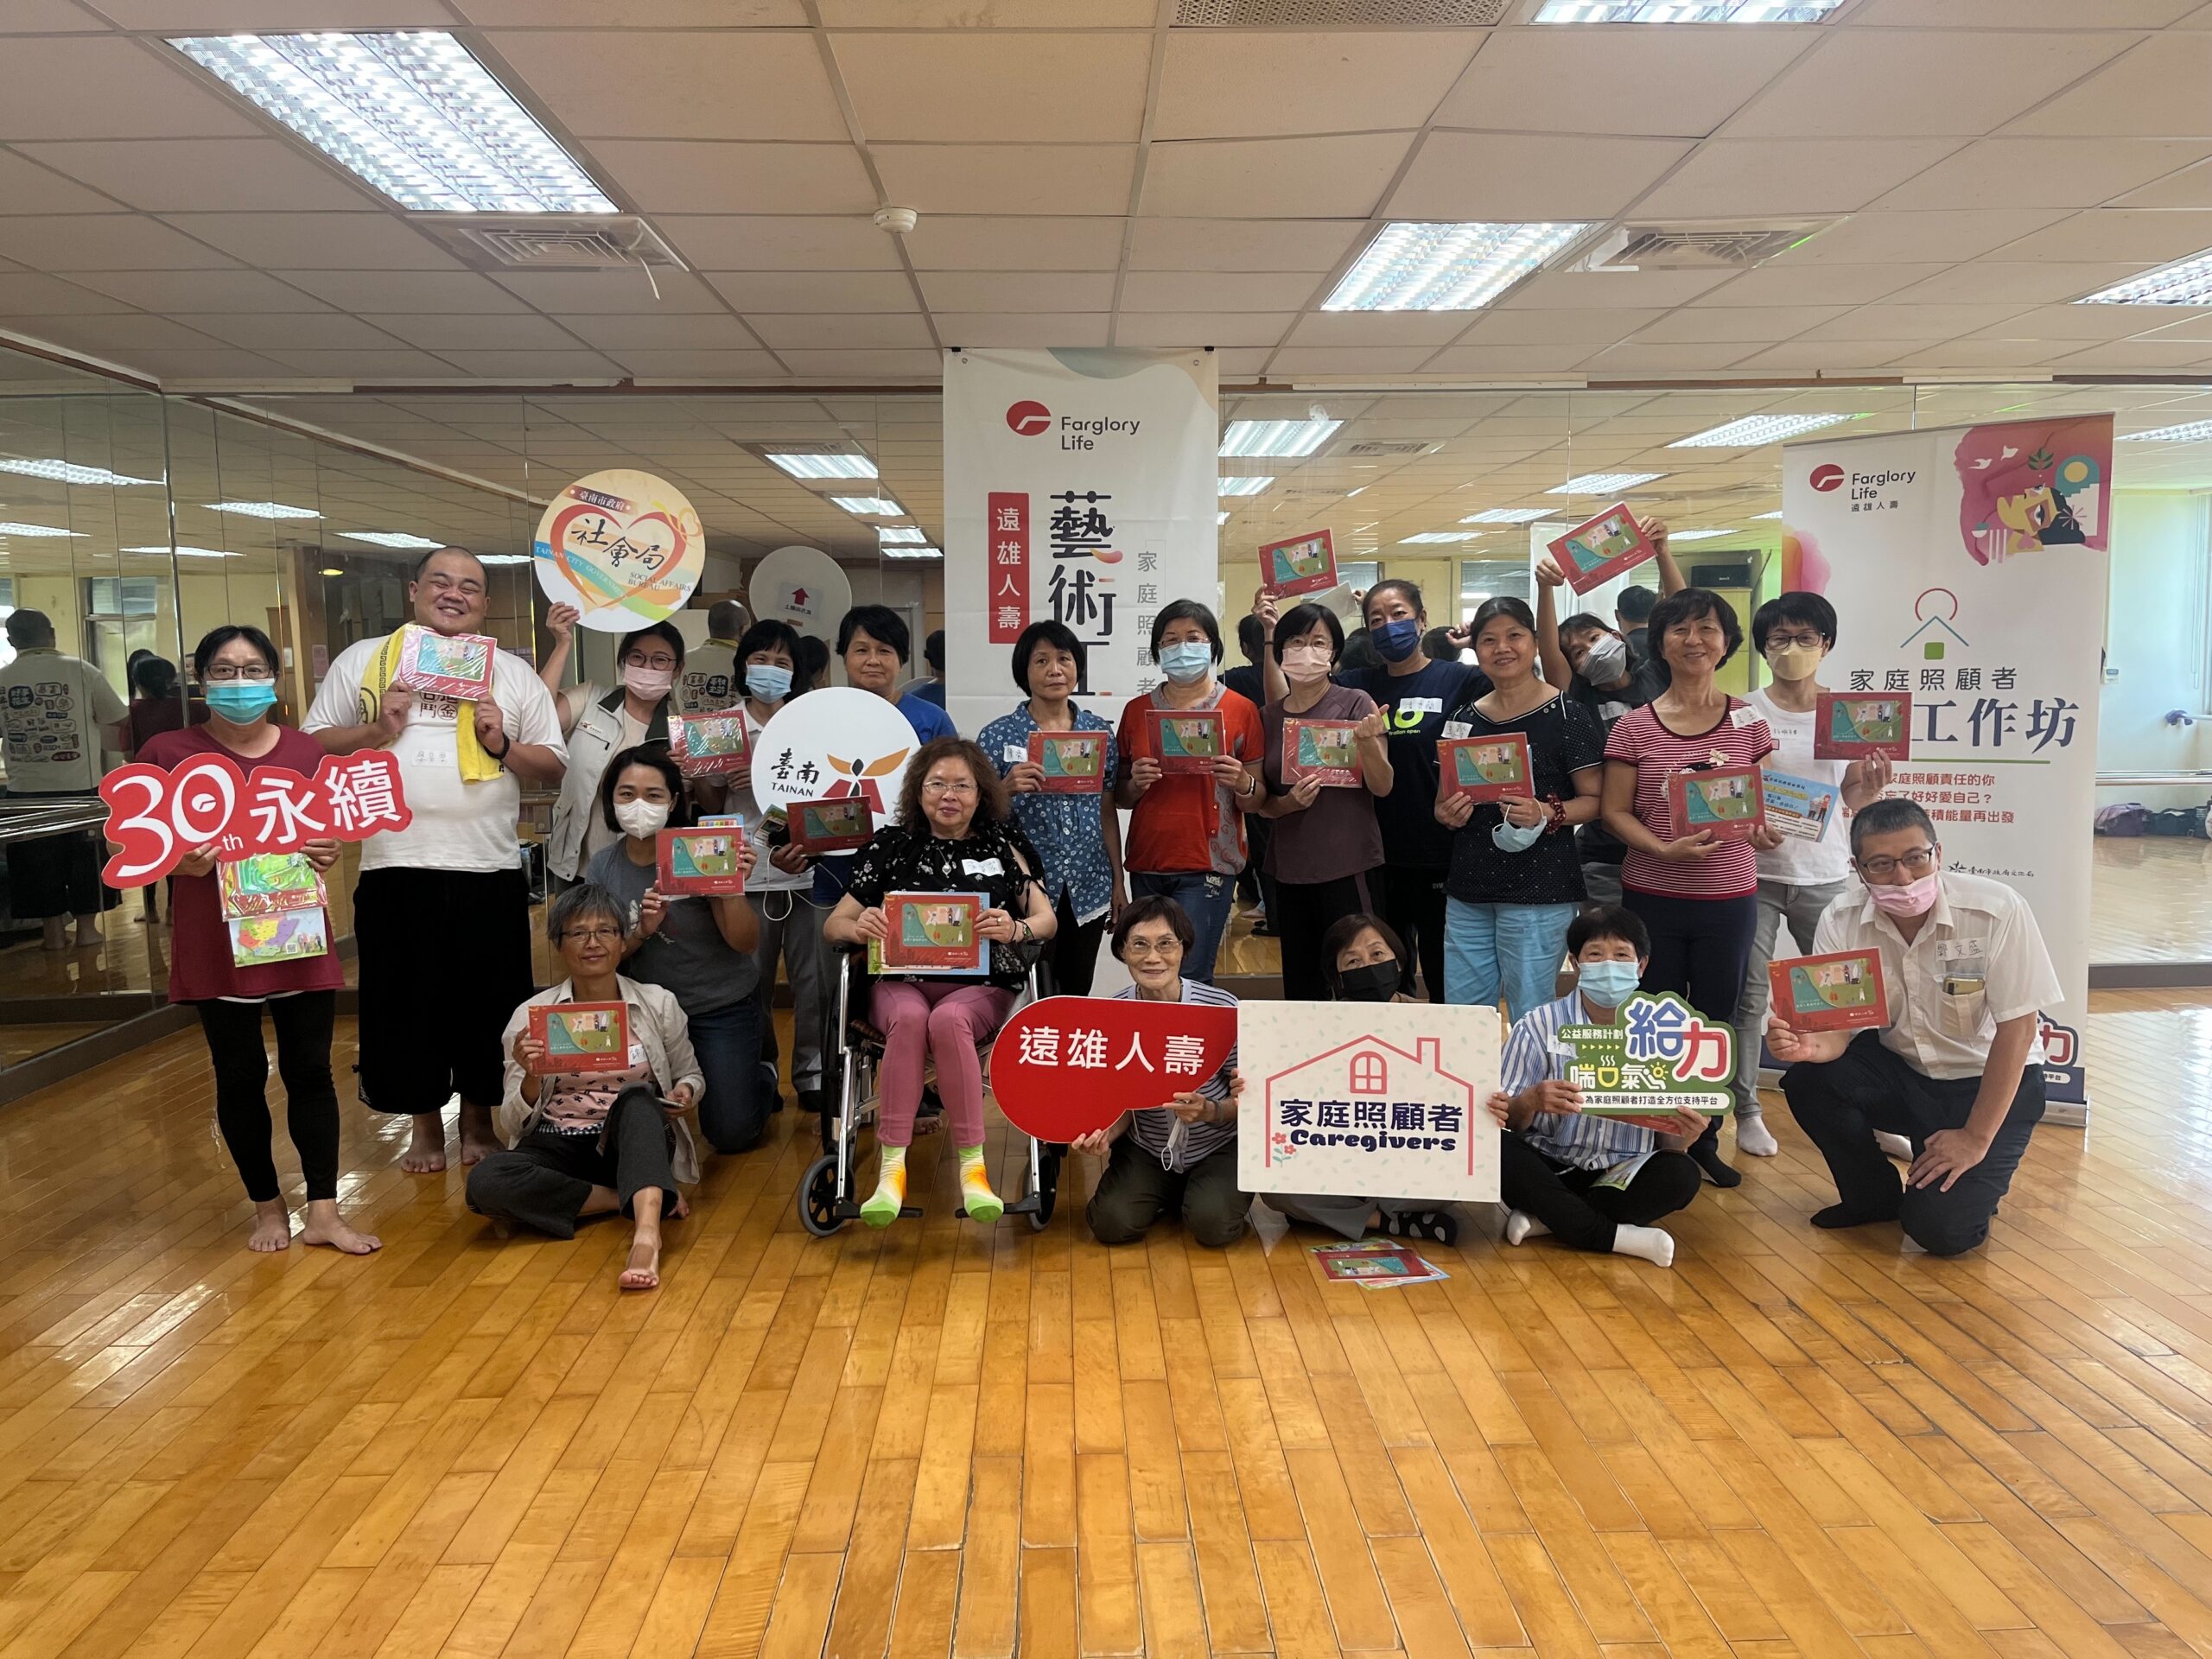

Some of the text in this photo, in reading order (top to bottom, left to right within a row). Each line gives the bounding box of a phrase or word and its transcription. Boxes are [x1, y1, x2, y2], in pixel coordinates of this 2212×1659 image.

[1062, 416, 1141, 435] Farglory
[1062, 435, 1095, 450] Life
[1852, 470, 1916, 486] Farglory
[1851, 486, 1878, 500] Life
[1851, 500, 1898, 512] 遠雄人壽
[571, 518, 665, 571] 社會局
[567, 555, 584, 567] CITY
[996, 507, 1022, 630] 遠雄人壽
[628, 578, 661, 591] BUREAU
[629, 571, 692, 592] SOCIAL AFFAIRS
[1850, 667, 2018, 691] 家庭照顧者
[1911, 697, 2080, 754] 工作坊
[771, 747, 820, 785] 臺南
[772, 782, 814, 797] TAINAN
[250, 760, 403, 845] 永續
[1925, 810, 2015, 823] 積能量再出發
[1560, 1028, 1624, 1040] 公益服務計劃
[1629, 1001, 1727, 1078] 給力
[1018, 1026, 1206, 1077] 遠雄人壽
[1586, 1095, 1719, 1106] 為家庭照顧者打造全方位支持平台
[1280, 1099, 1463, 1133] 家庭照顧者
[1290, 1129, 1456, 1153] Caregivers
